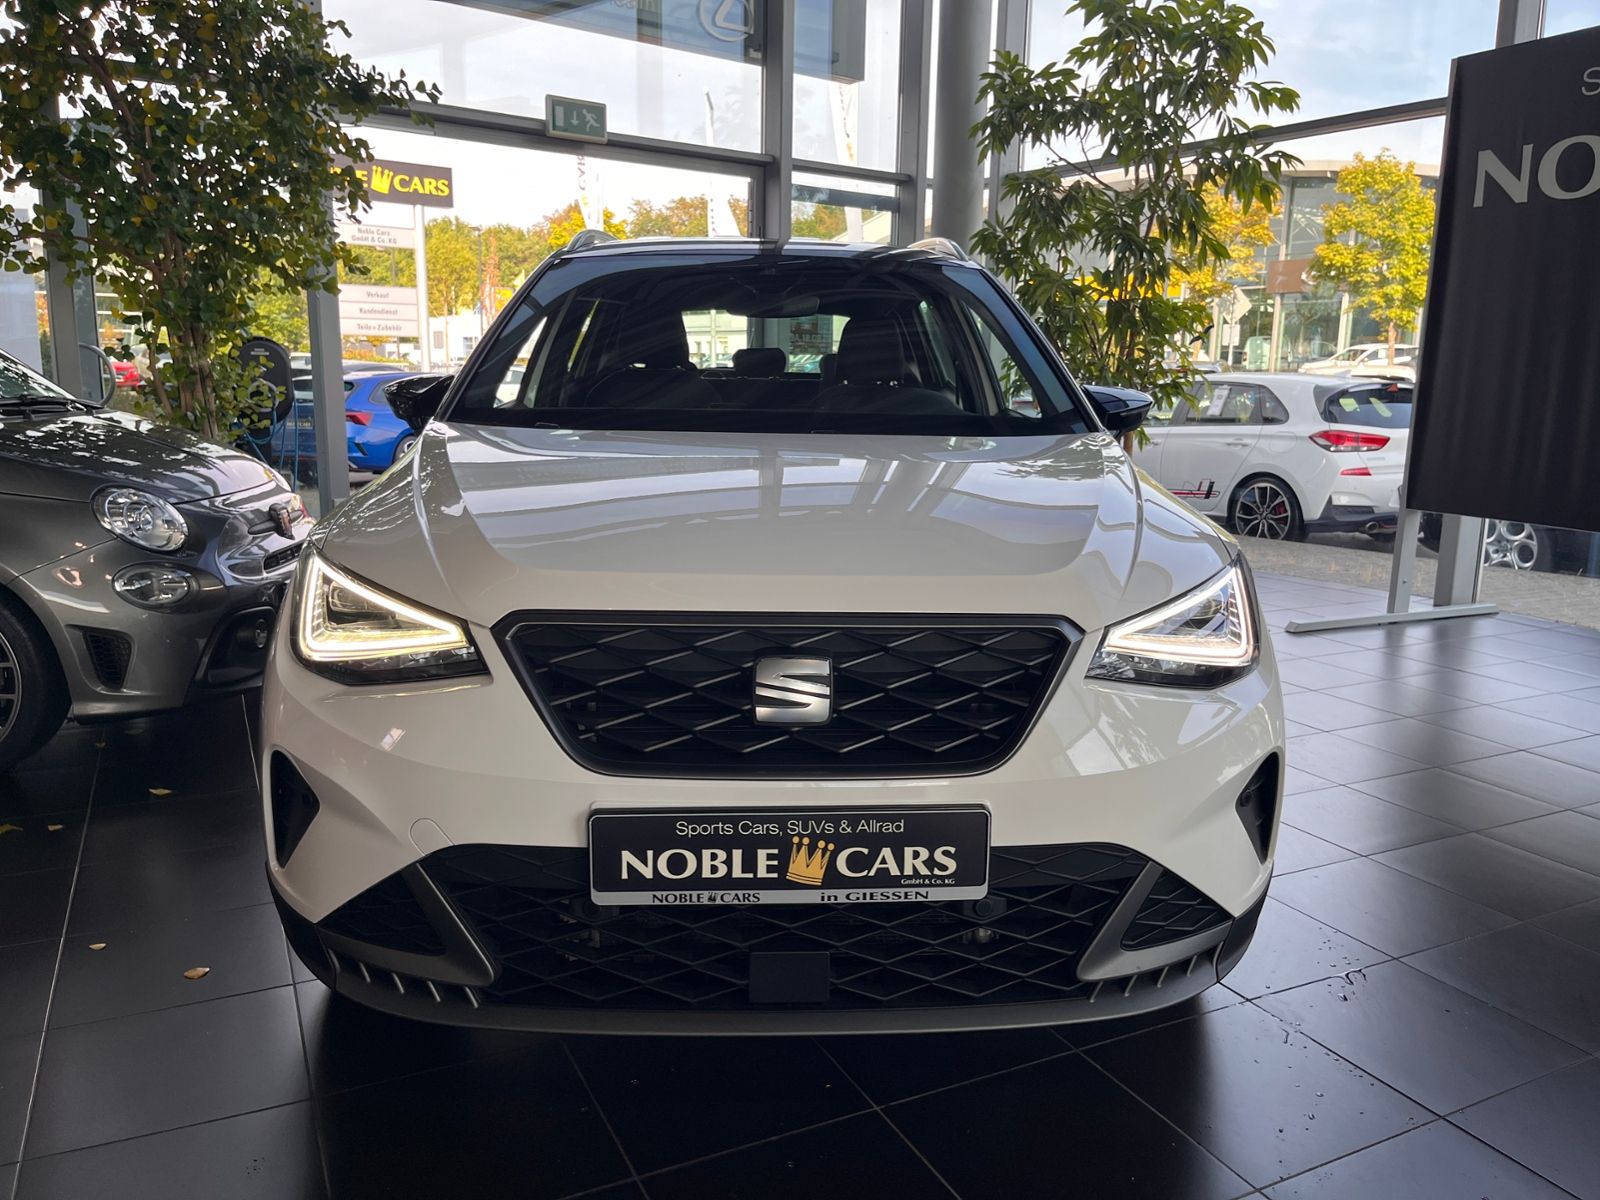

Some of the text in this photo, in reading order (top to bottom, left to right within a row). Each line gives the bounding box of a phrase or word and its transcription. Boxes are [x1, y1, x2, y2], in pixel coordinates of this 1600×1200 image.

[1473, 134, 1600, 208] NO
[393, 174, 450, 197] CARS
[357, 227, 391, 237] Noble Cars
[351, 235, 370, 243] GmbH
[388, 237, 398, 245] KG
[366, 291, 390, 299] Verkauf
[359, 307, 399, 316] Kundendienst
[357, 323, 372, 331] Teile
[675, 819, 905, 838] Sports Cars, SUVs & Allrad
[621, 846, 957, 880] NOBLE CARS
[652, 892, 761, 904] NOBLE CARS
[820, 890, 929, 902] in GIESSEN
